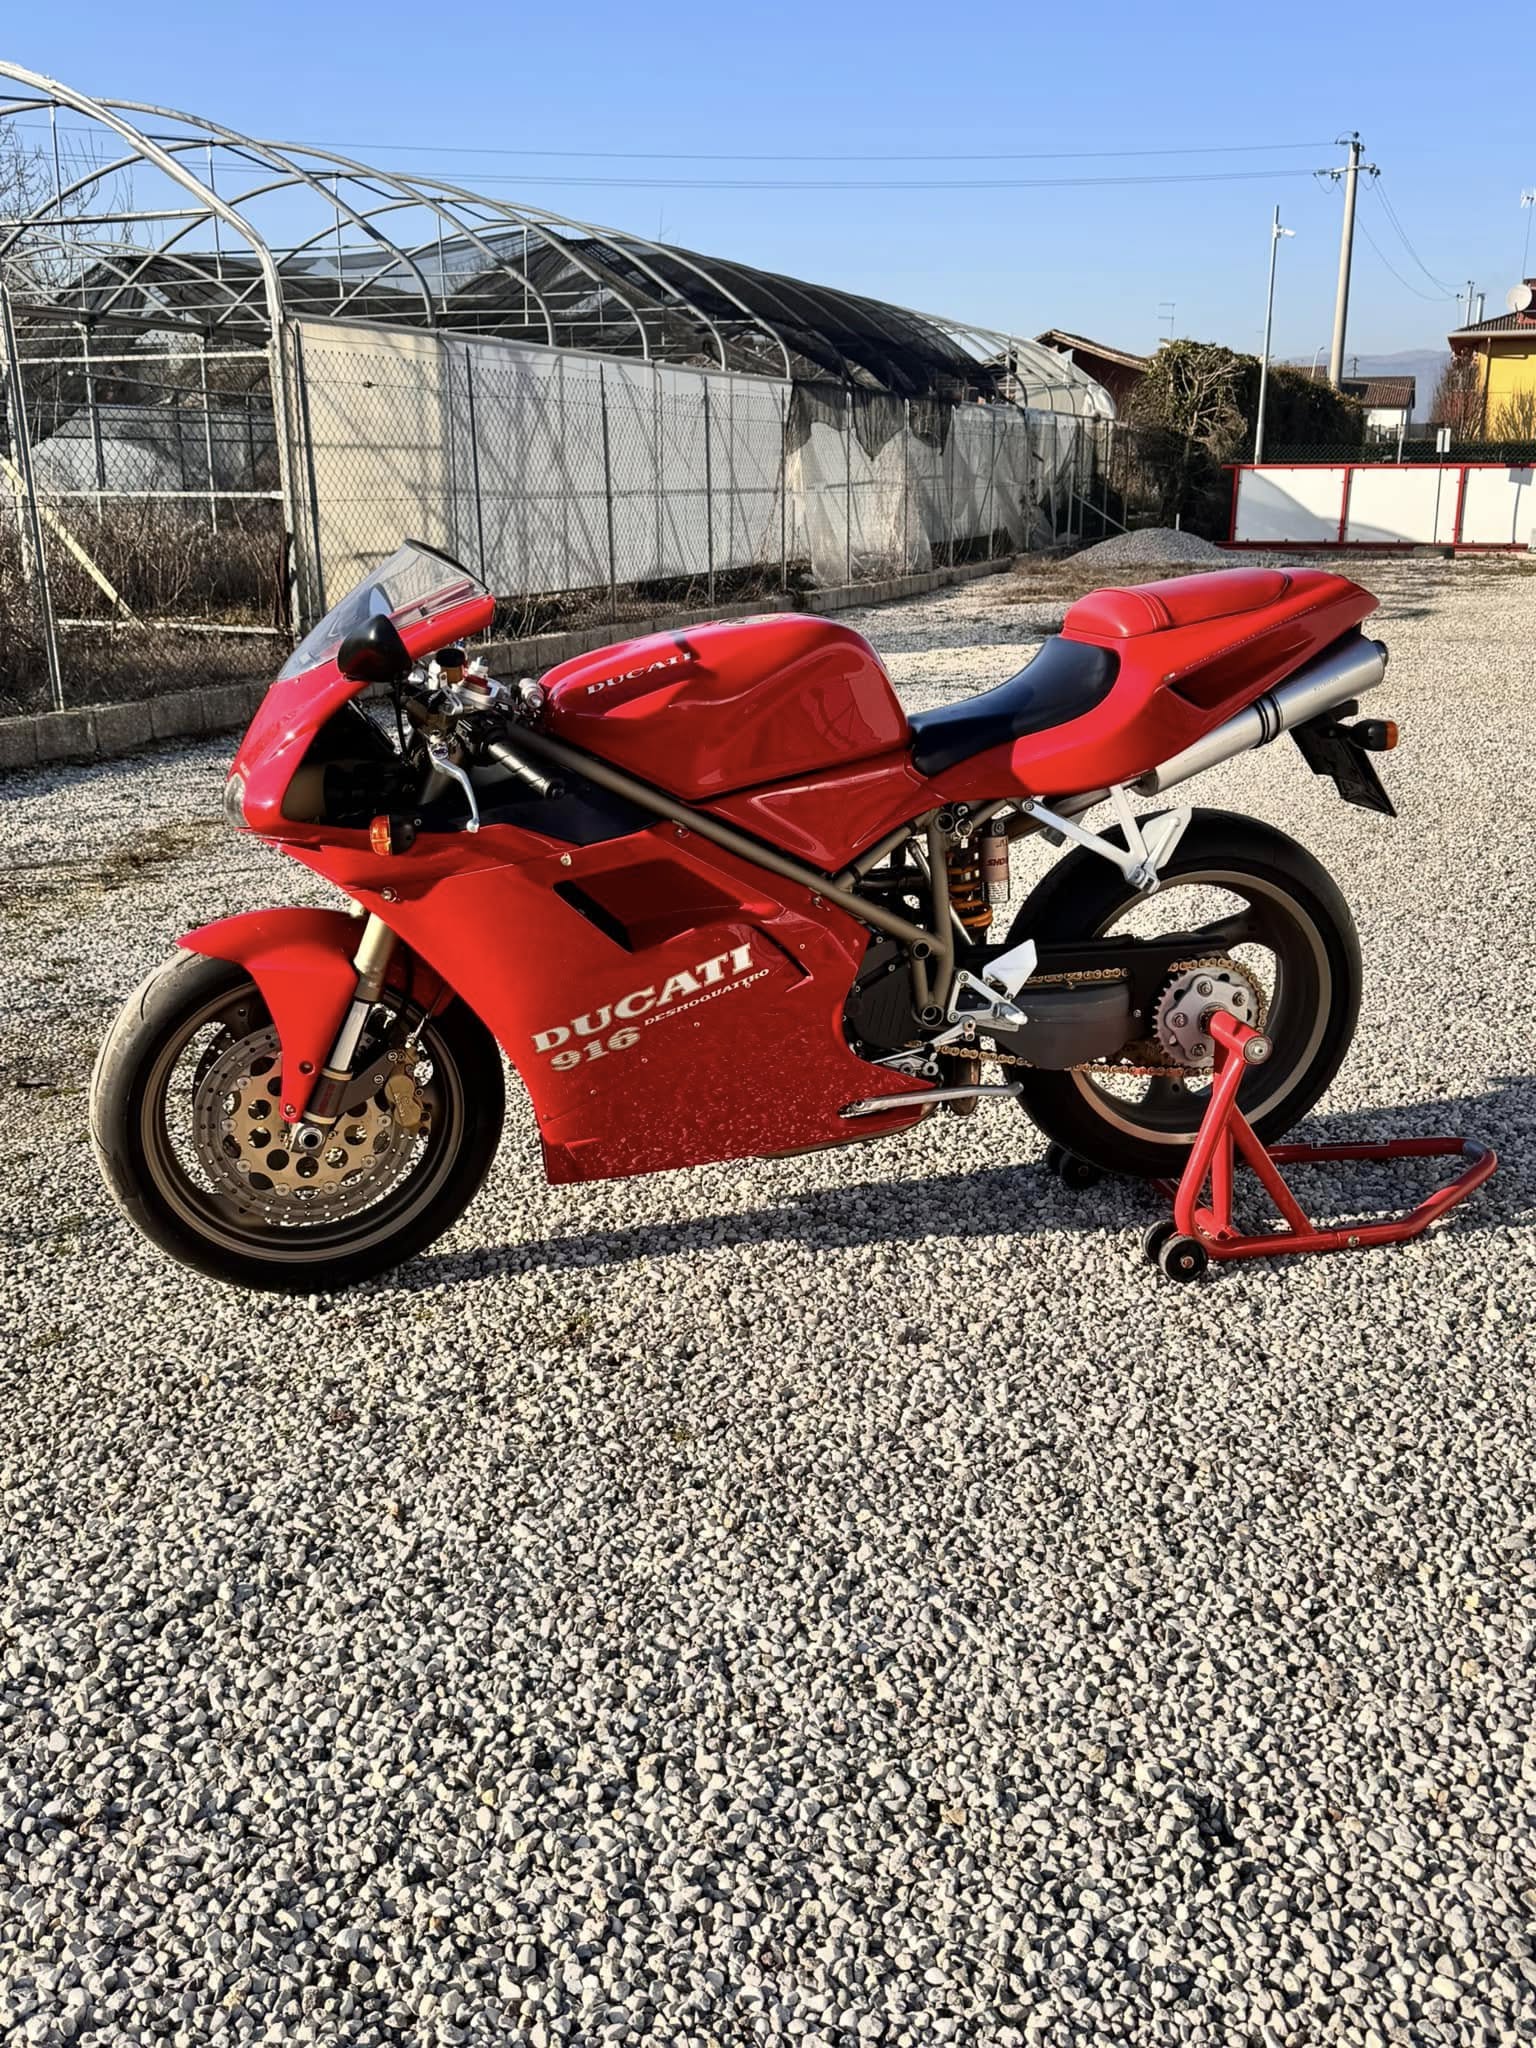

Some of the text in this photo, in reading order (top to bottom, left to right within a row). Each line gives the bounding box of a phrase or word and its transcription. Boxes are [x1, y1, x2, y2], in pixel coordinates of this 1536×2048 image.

[587, 652, 691, 694] DUCATI
[531, 942, 754, 1053] DUCATI
[644, 968, 770, 1026] DESMOQUATTRO
[550, 1026, 641, 1071] 916
